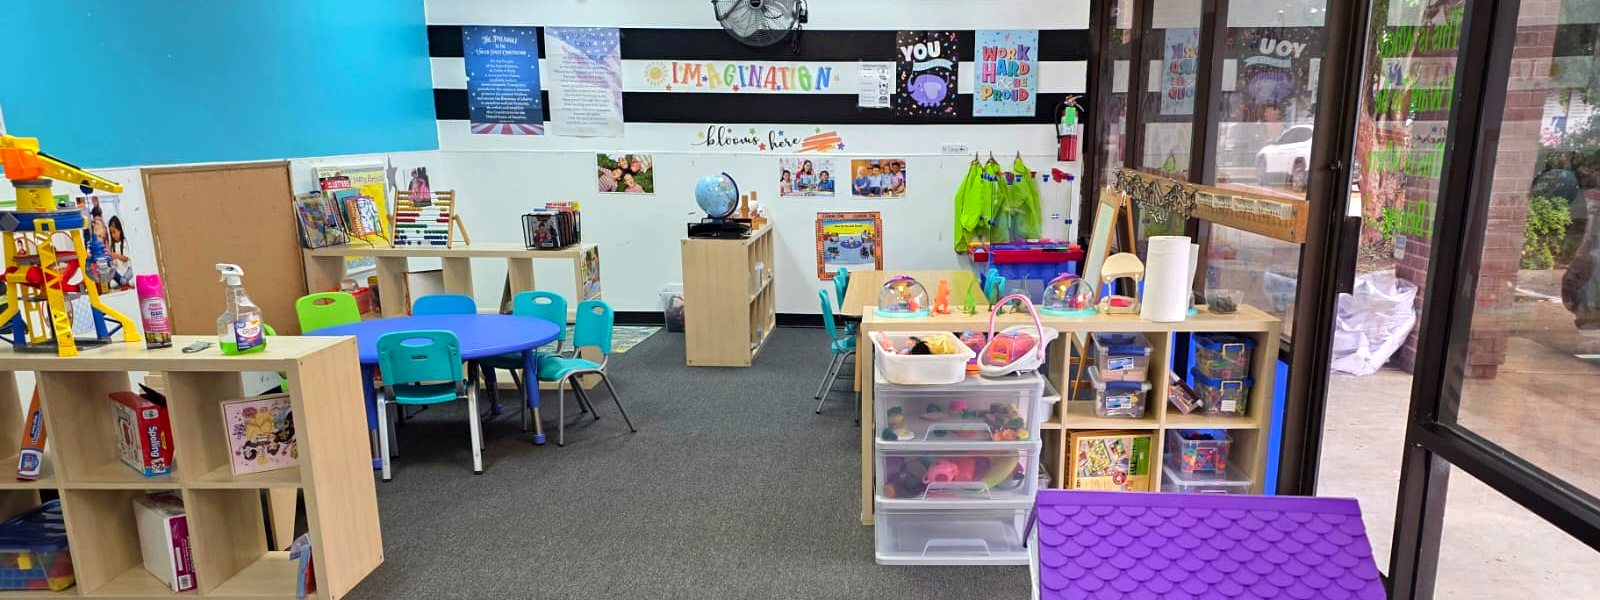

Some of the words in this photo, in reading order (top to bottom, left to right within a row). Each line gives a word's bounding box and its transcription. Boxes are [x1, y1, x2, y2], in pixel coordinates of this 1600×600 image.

[900, 41, 941, 61] YOU
[982, 44, 1030, 61] WORK
[671, 61, 832, 92] IMAGINATION
[982, 60, 1030, 84] HARD
[981, 85, 1029, 102] PROUD
[691, 125, 760, 147] blooms
[768, 130, 801, 151] here
